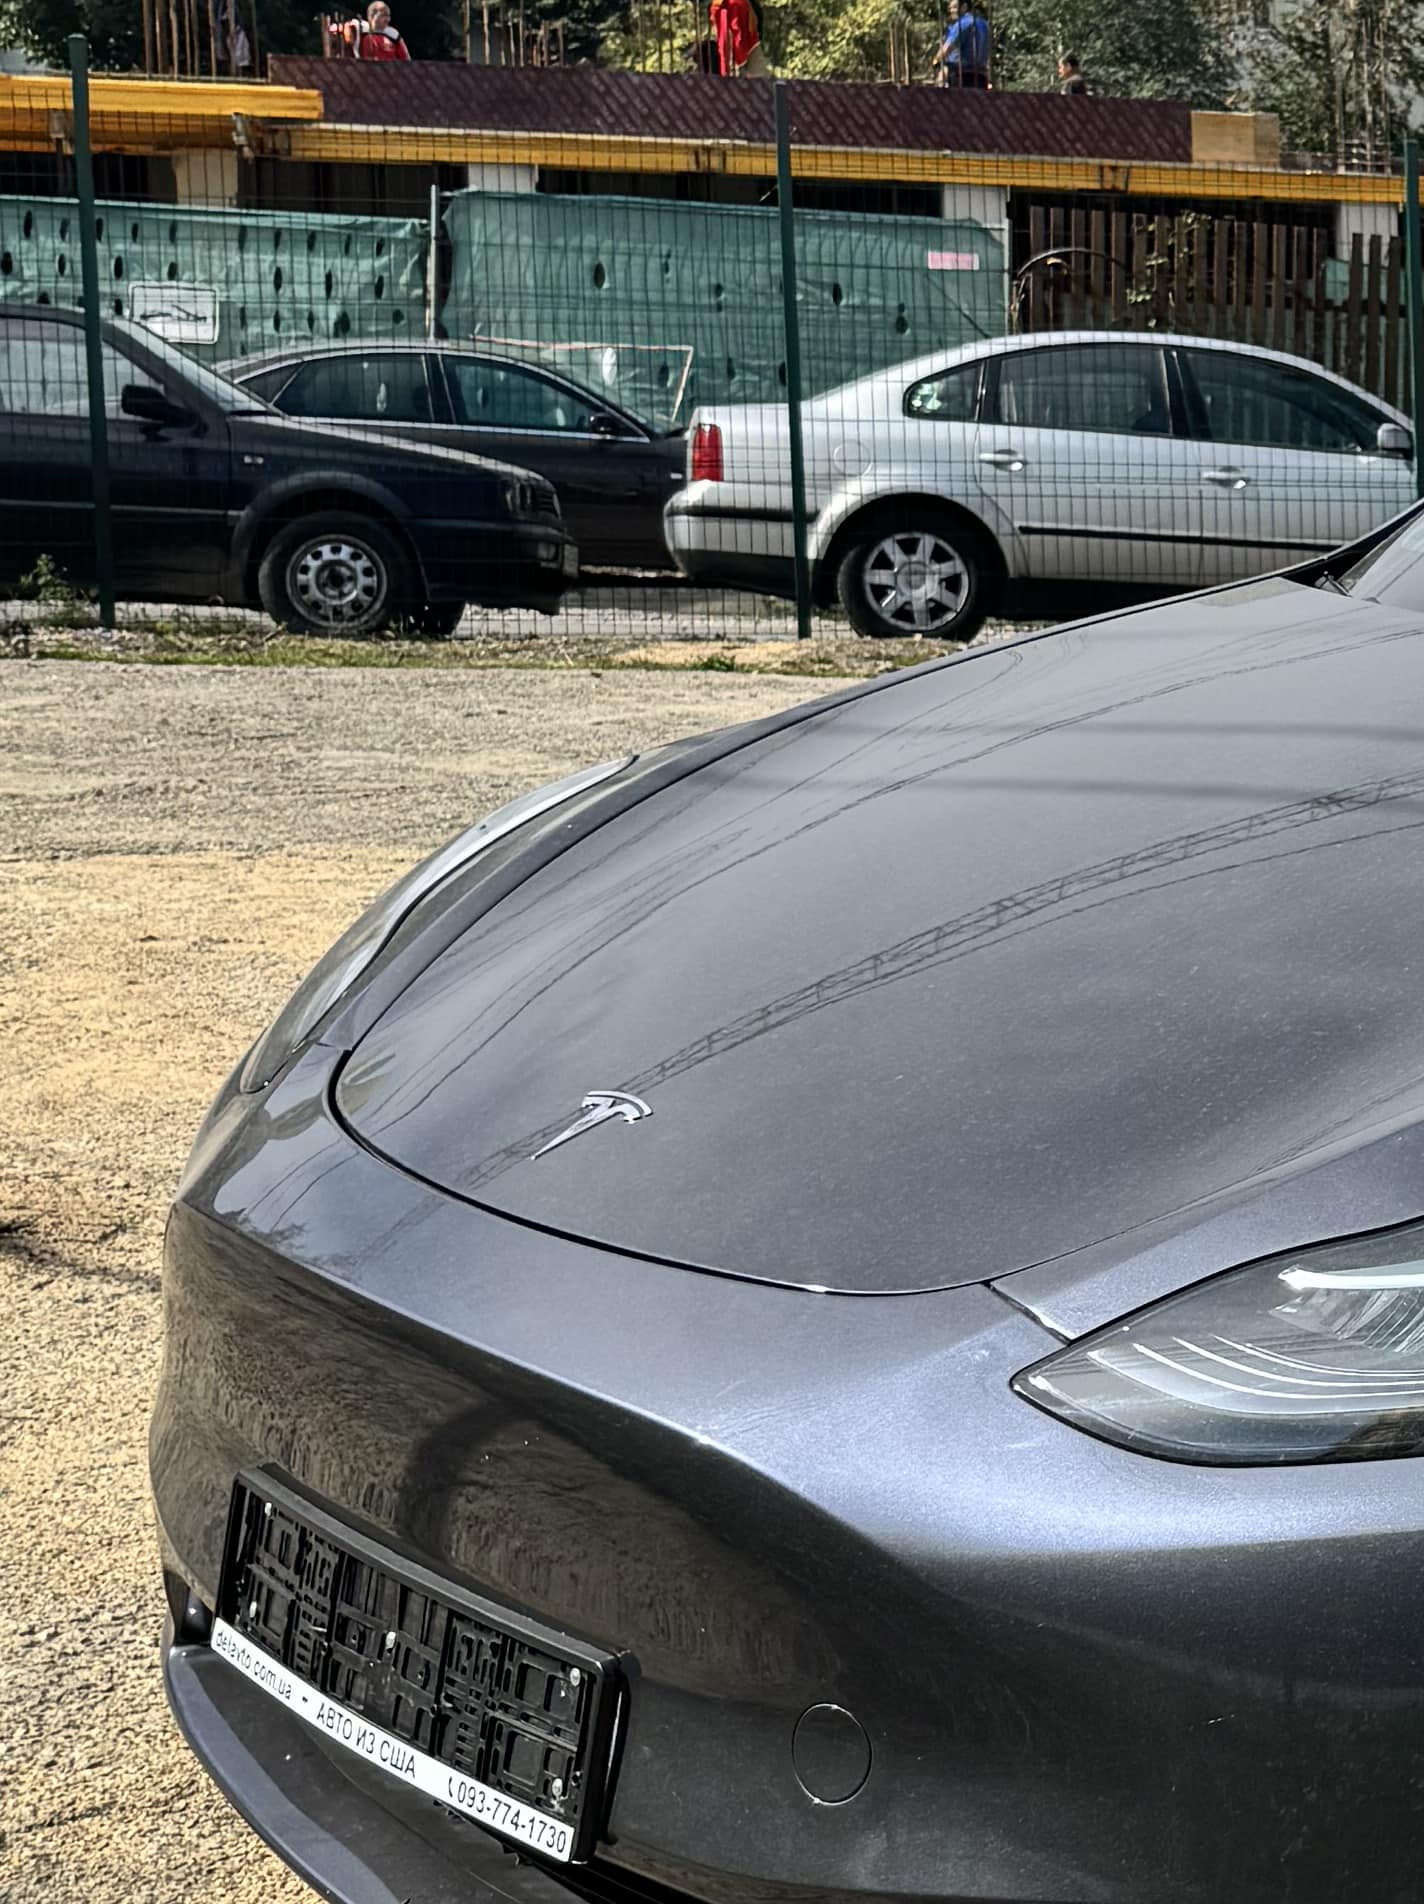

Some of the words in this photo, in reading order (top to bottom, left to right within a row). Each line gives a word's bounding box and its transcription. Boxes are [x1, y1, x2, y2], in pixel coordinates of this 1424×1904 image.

[316, 1702, 353, 1740] АВТО
[356, 1726, 376, 1755] ИЗ
[379, 1740, 416, 1778] США
[457, 1780, 567, 1854] 093-774-1730
